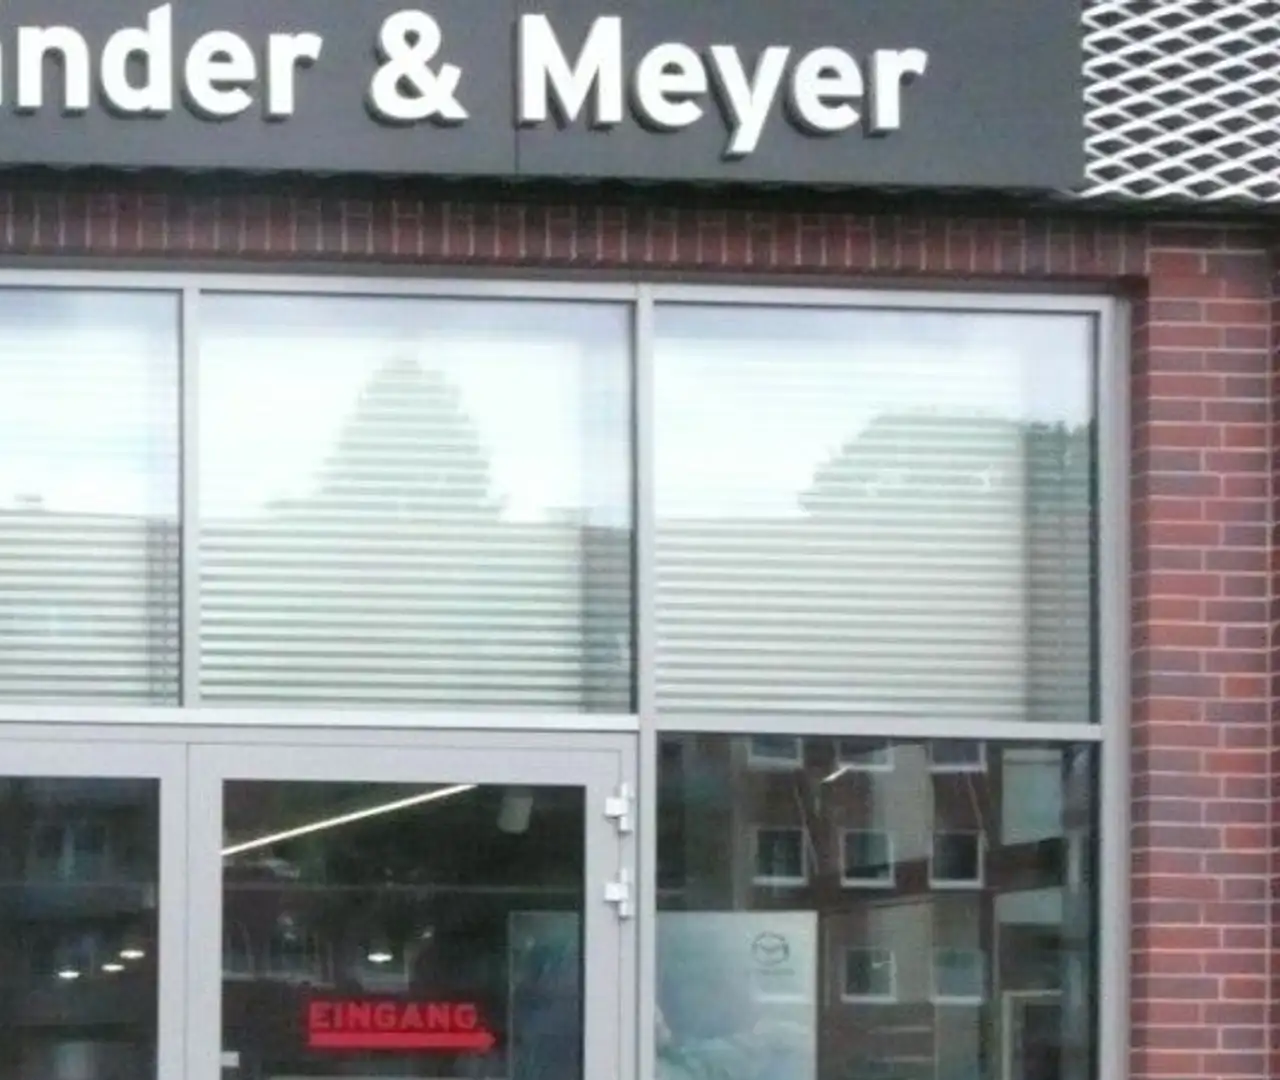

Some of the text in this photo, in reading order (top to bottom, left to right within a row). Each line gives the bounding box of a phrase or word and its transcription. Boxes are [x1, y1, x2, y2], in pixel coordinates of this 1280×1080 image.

[370, 10, 468, 121] &
[517, 14, 928, 154] Meyer
[309, 1001, 478, 1030] EINGANG
